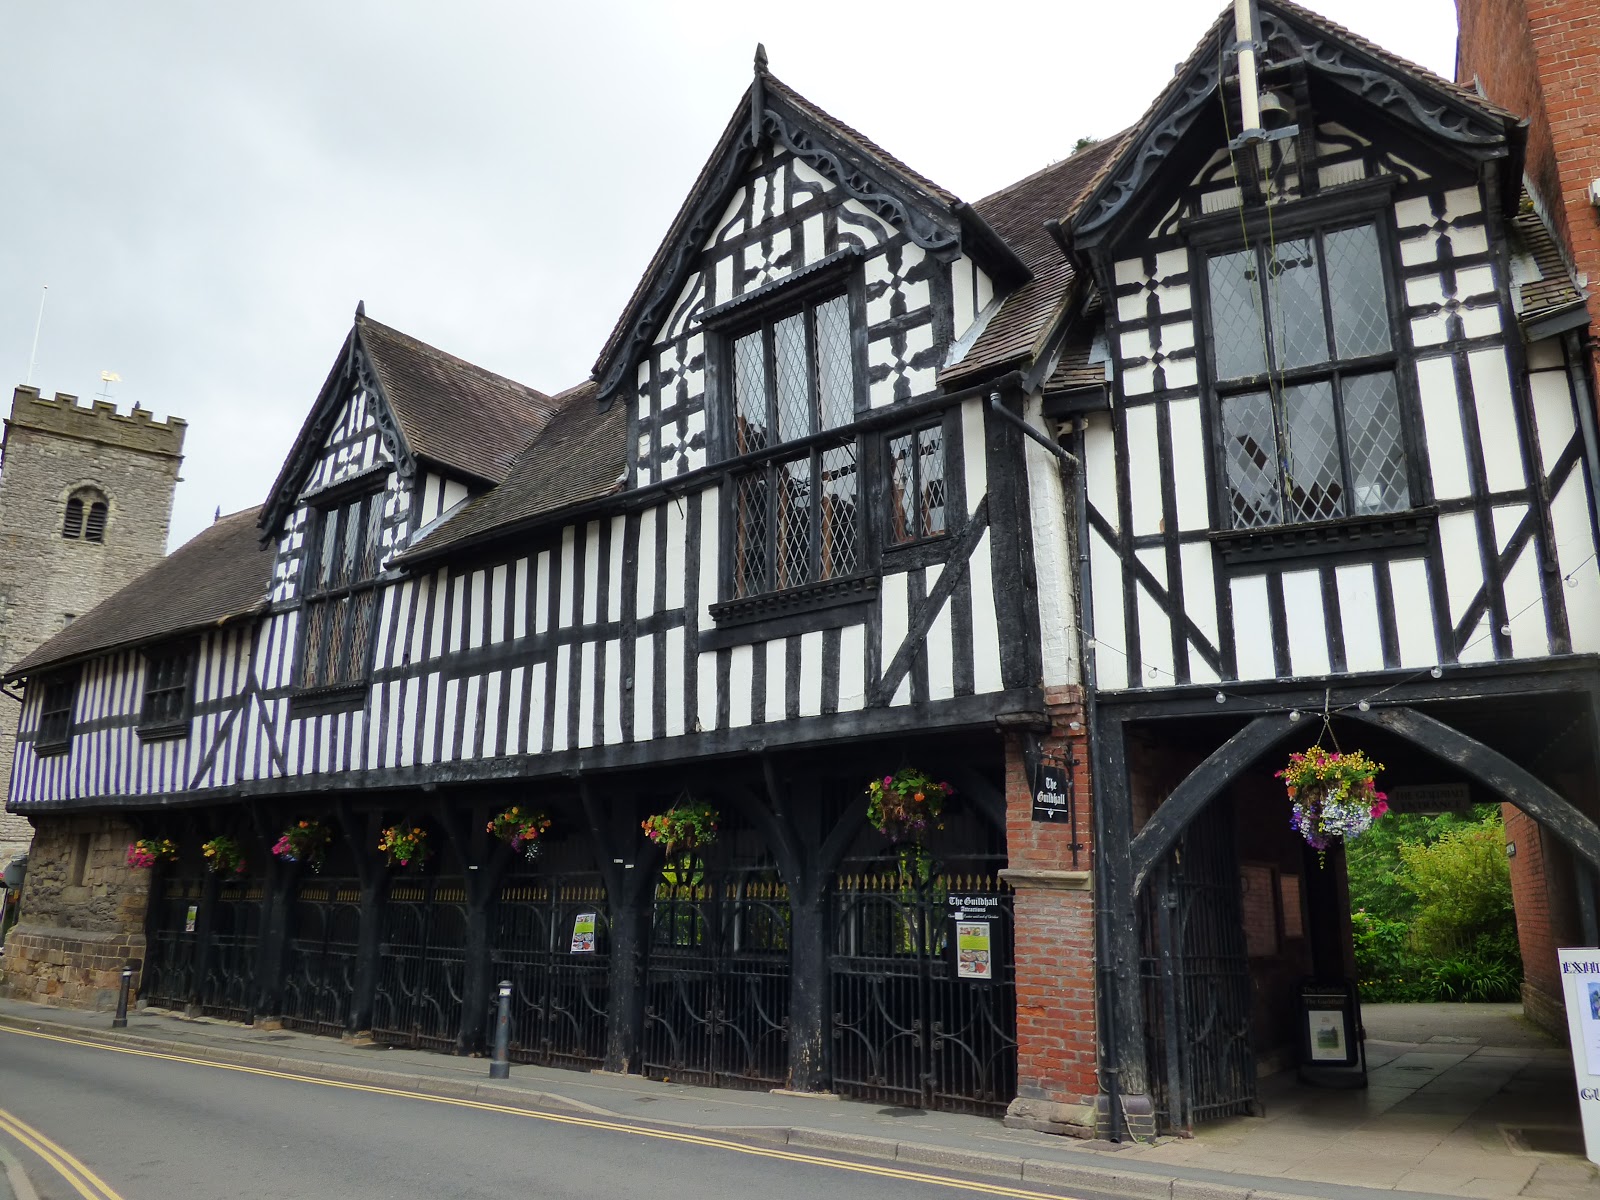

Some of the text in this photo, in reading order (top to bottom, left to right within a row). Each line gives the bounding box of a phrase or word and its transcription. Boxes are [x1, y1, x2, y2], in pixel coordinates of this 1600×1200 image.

[1045, 777, 1057, 791] The
[1037, 790, 1065, 805] Guildhall
[1395, 791, 1415, 801] THE
[949, 896, 998, 906] The Guildhall
